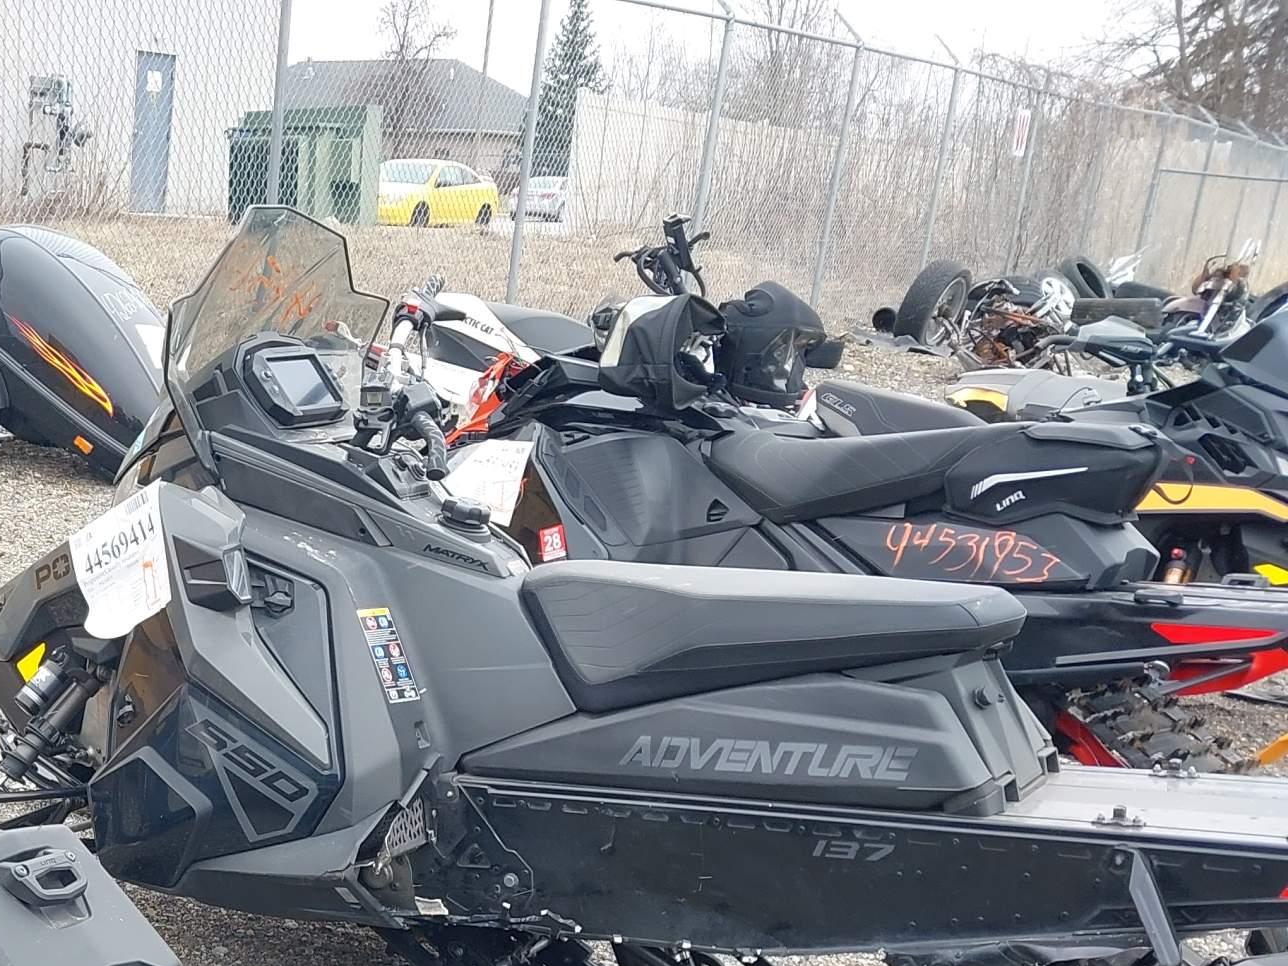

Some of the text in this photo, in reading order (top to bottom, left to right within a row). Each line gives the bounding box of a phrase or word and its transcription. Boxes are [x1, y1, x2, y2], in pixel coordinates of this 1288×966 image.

[480, 324, 494, 335] CAT
[85, 512, 156, 574] 44569414
[423, 543, 489, 571] MATRYX
[544, 532, 562, 553] 28
[34, 553, 72, 591] PO
[185, 718, 310, 803] 650
[619, 735, 919, 782] ADVENTURE
[812, 839, 896, 861] 137
